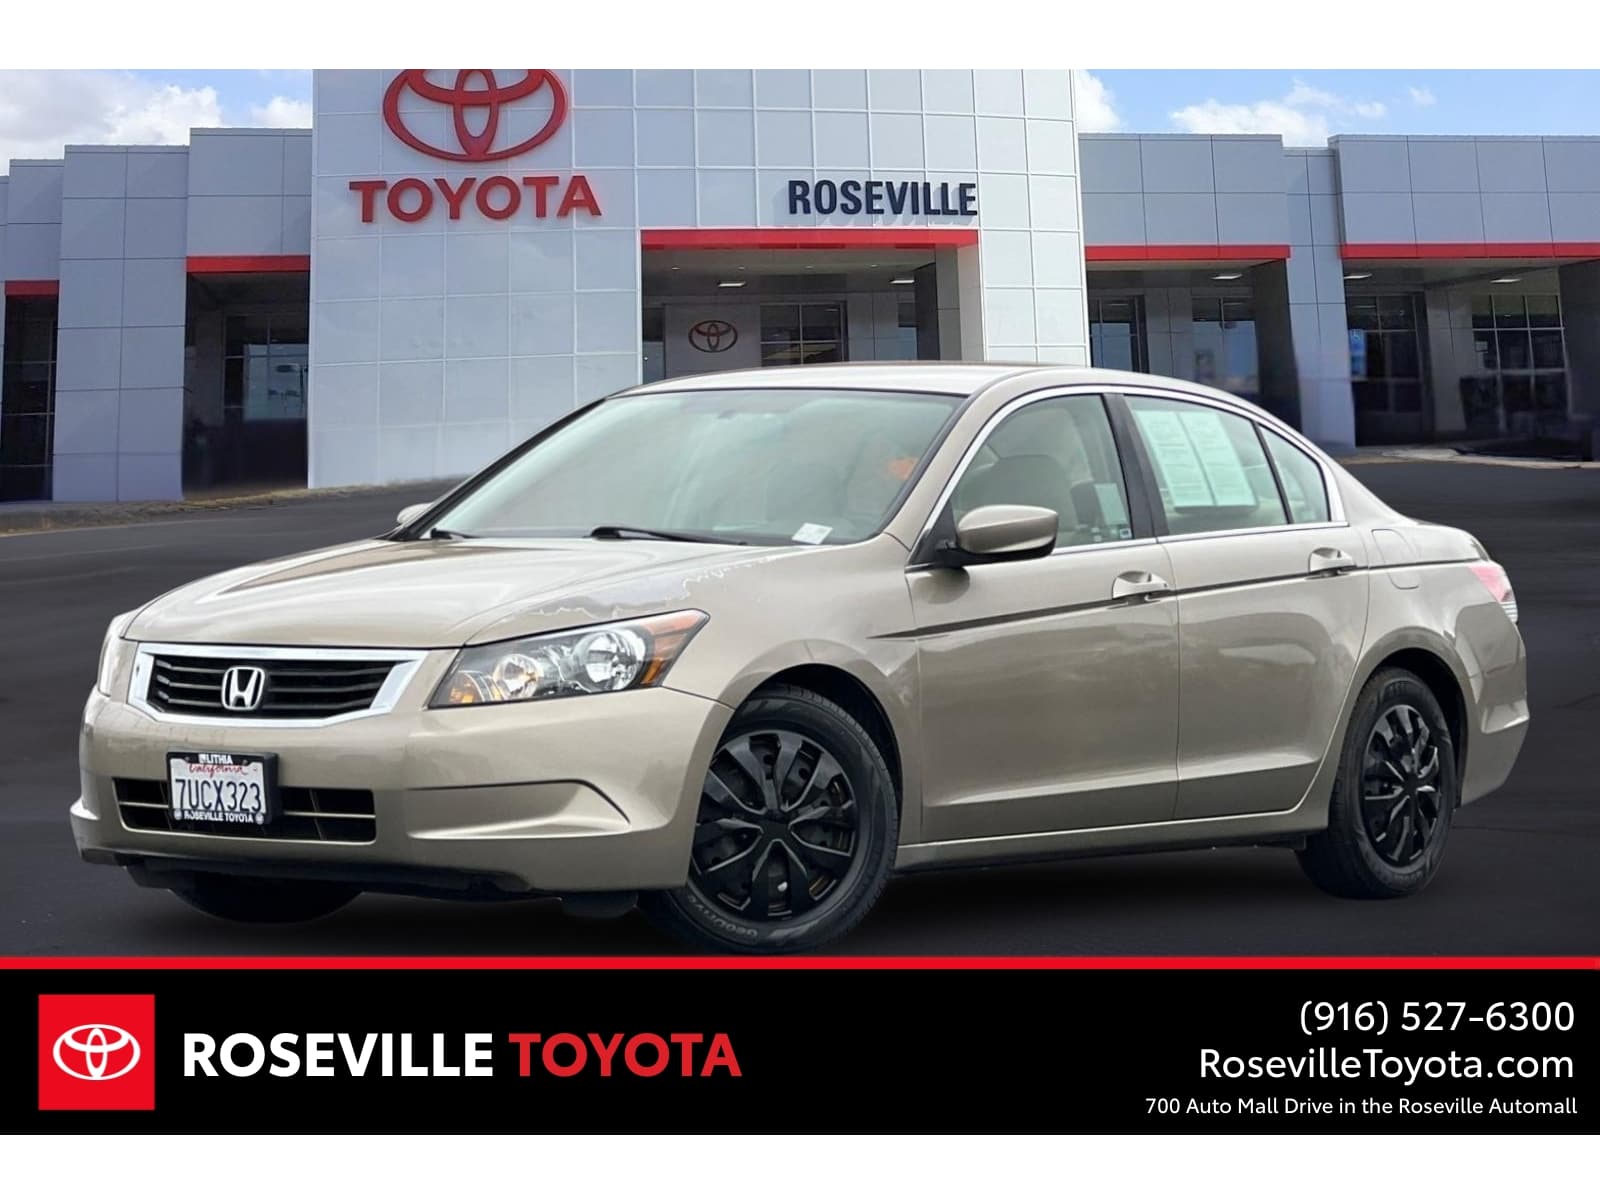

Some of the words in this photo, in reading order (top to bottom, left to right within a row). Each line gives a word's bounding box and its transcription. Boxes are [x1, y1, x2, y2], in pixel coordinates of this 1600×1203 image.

[349, 175, 602, 223] TOYOTA
[788, 180, 978, 216] ROSEVILLE
[175, 778, 261, 812] 7UCX323
[184, 810, 224, 821] ROSEVILLE
[225, 812, 254, 823] TOYOTA
